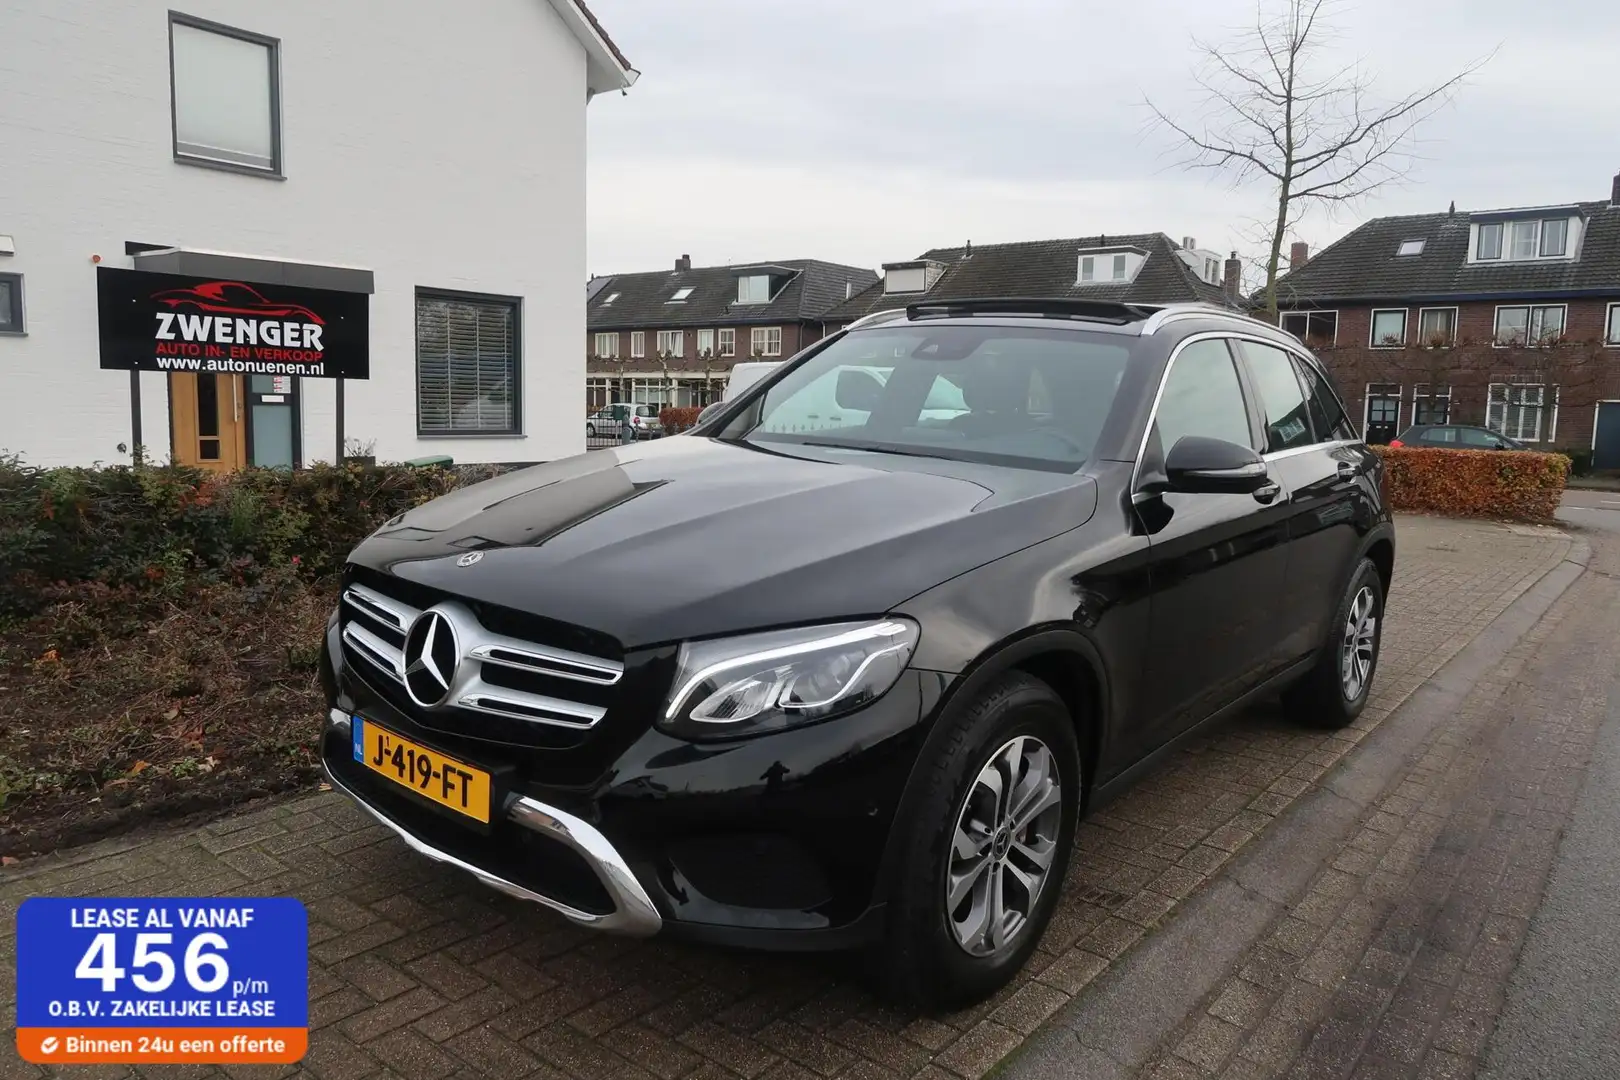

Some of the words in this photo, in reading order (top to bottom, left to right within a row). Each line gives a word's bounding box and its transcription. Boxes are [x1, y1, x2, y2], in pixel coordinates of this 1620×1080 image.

[155, 312, 324, 351] ZWENGER
[155, 342, 200, 356] AUTO
[204, 347, 225, 358] IN-
[231, 349, 250, 359] EN
[255, 349, 323, 362] VERKOOP
[157, 357, 324, 375] www.autonuenen.nl
[373, 734, 473, 808] J-419-FT
